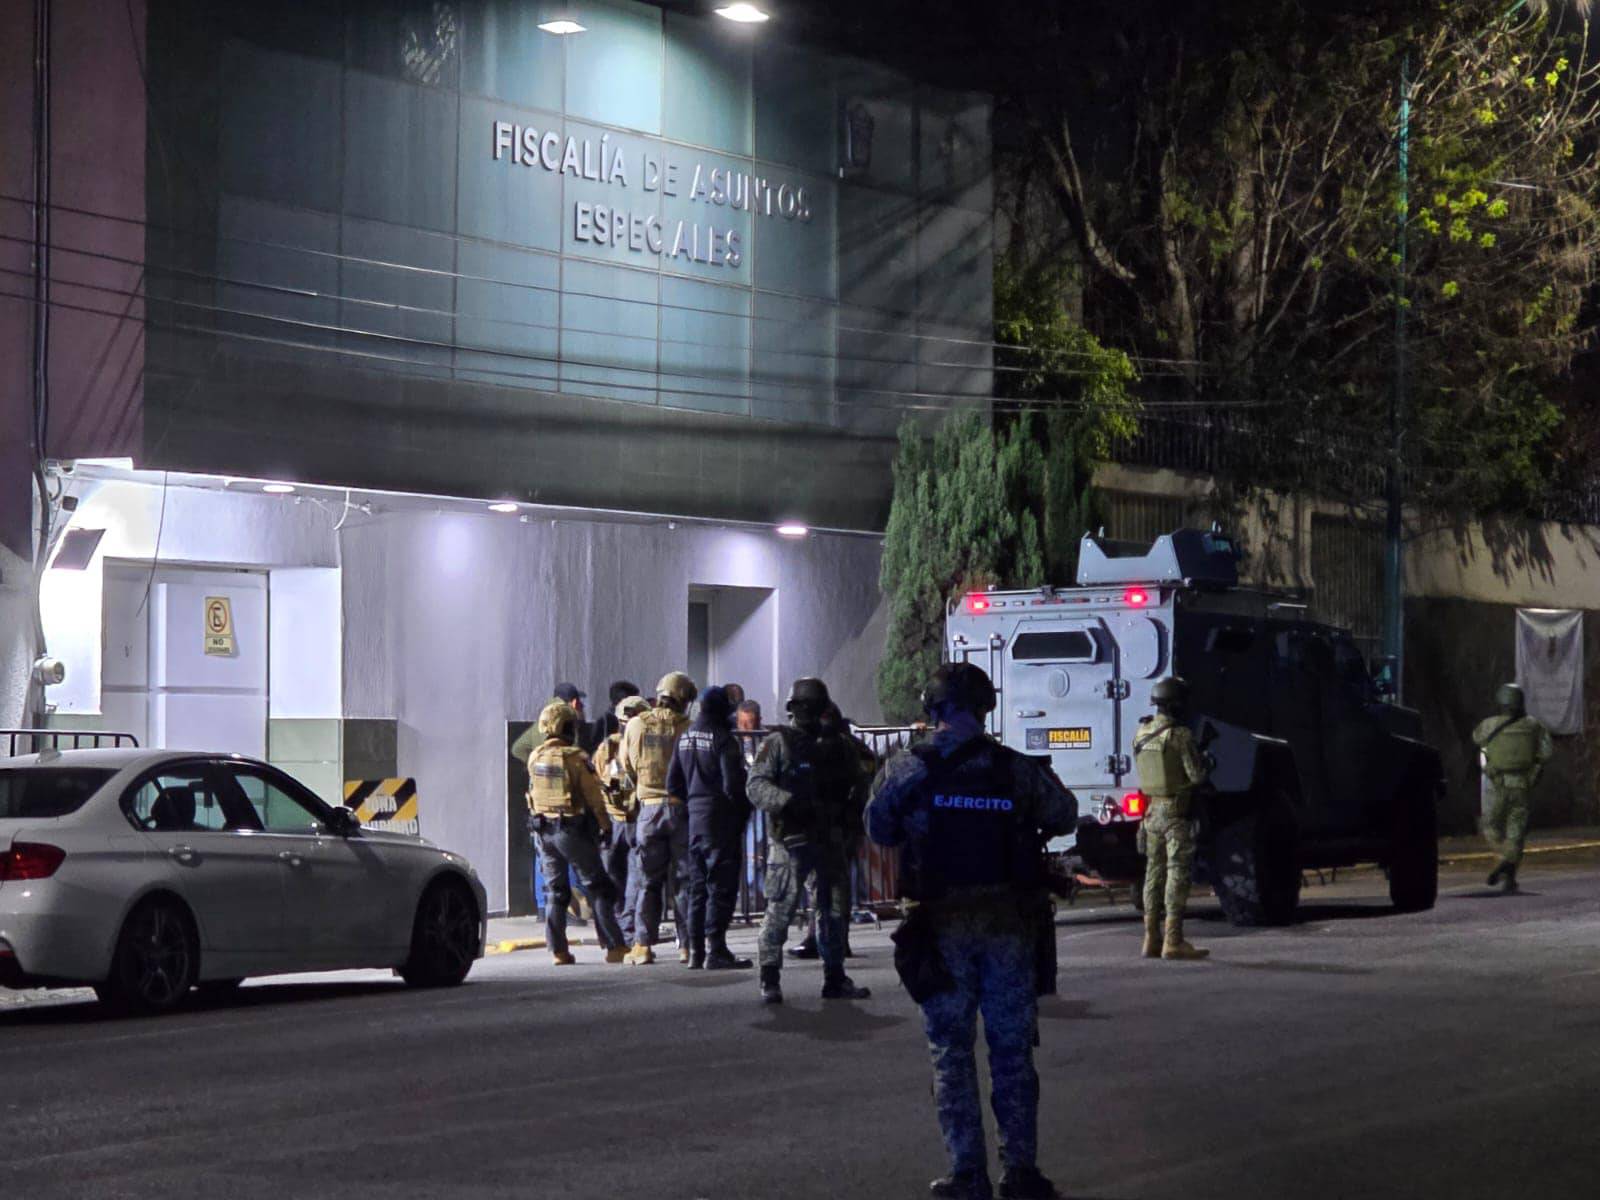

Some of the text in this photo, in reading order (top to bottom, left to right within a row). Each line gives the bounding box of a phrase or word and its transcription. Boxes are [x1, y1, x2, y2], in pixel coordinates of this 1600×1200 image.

[493, 120, 813, 225] FISCALÍA DE ASUNTOS
[574, 201, 743, 268] ESPECALES
